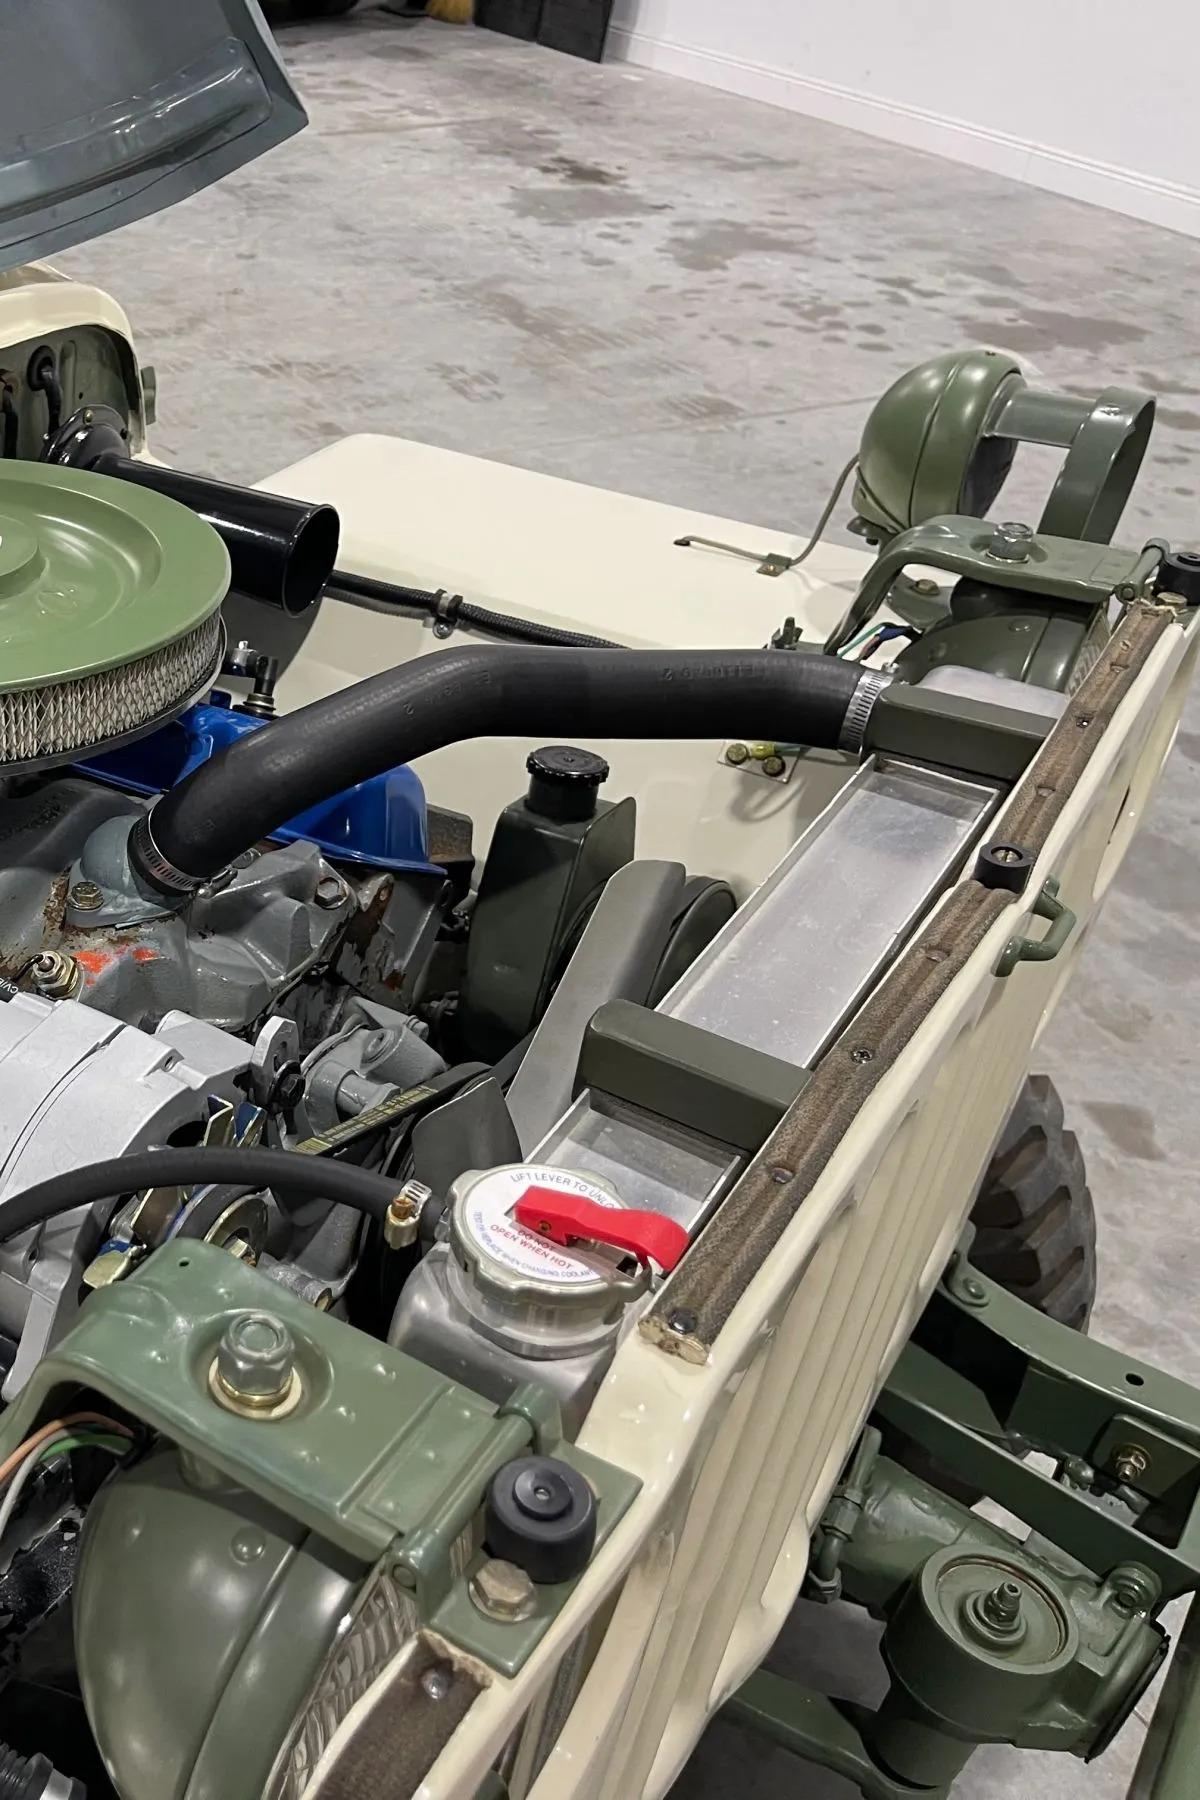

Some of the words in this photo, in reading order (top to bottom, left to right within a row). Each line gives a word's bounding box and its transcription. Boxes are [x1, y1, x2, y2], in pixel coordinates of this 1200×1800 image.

[510, 1172, 531, 1183] LIFT
[535, 1173, 571, 1185] LEVER
[573, 1181, 588, 1192] TO
[490, 1224, 519, 1242] OPEN
[520, 1239, 550, 1258] WHEN
[550, 1256, 574, 1270] HOT
[518, 1230, 533, 1240] DO
[534, 1237, 557, 1251] NOT
